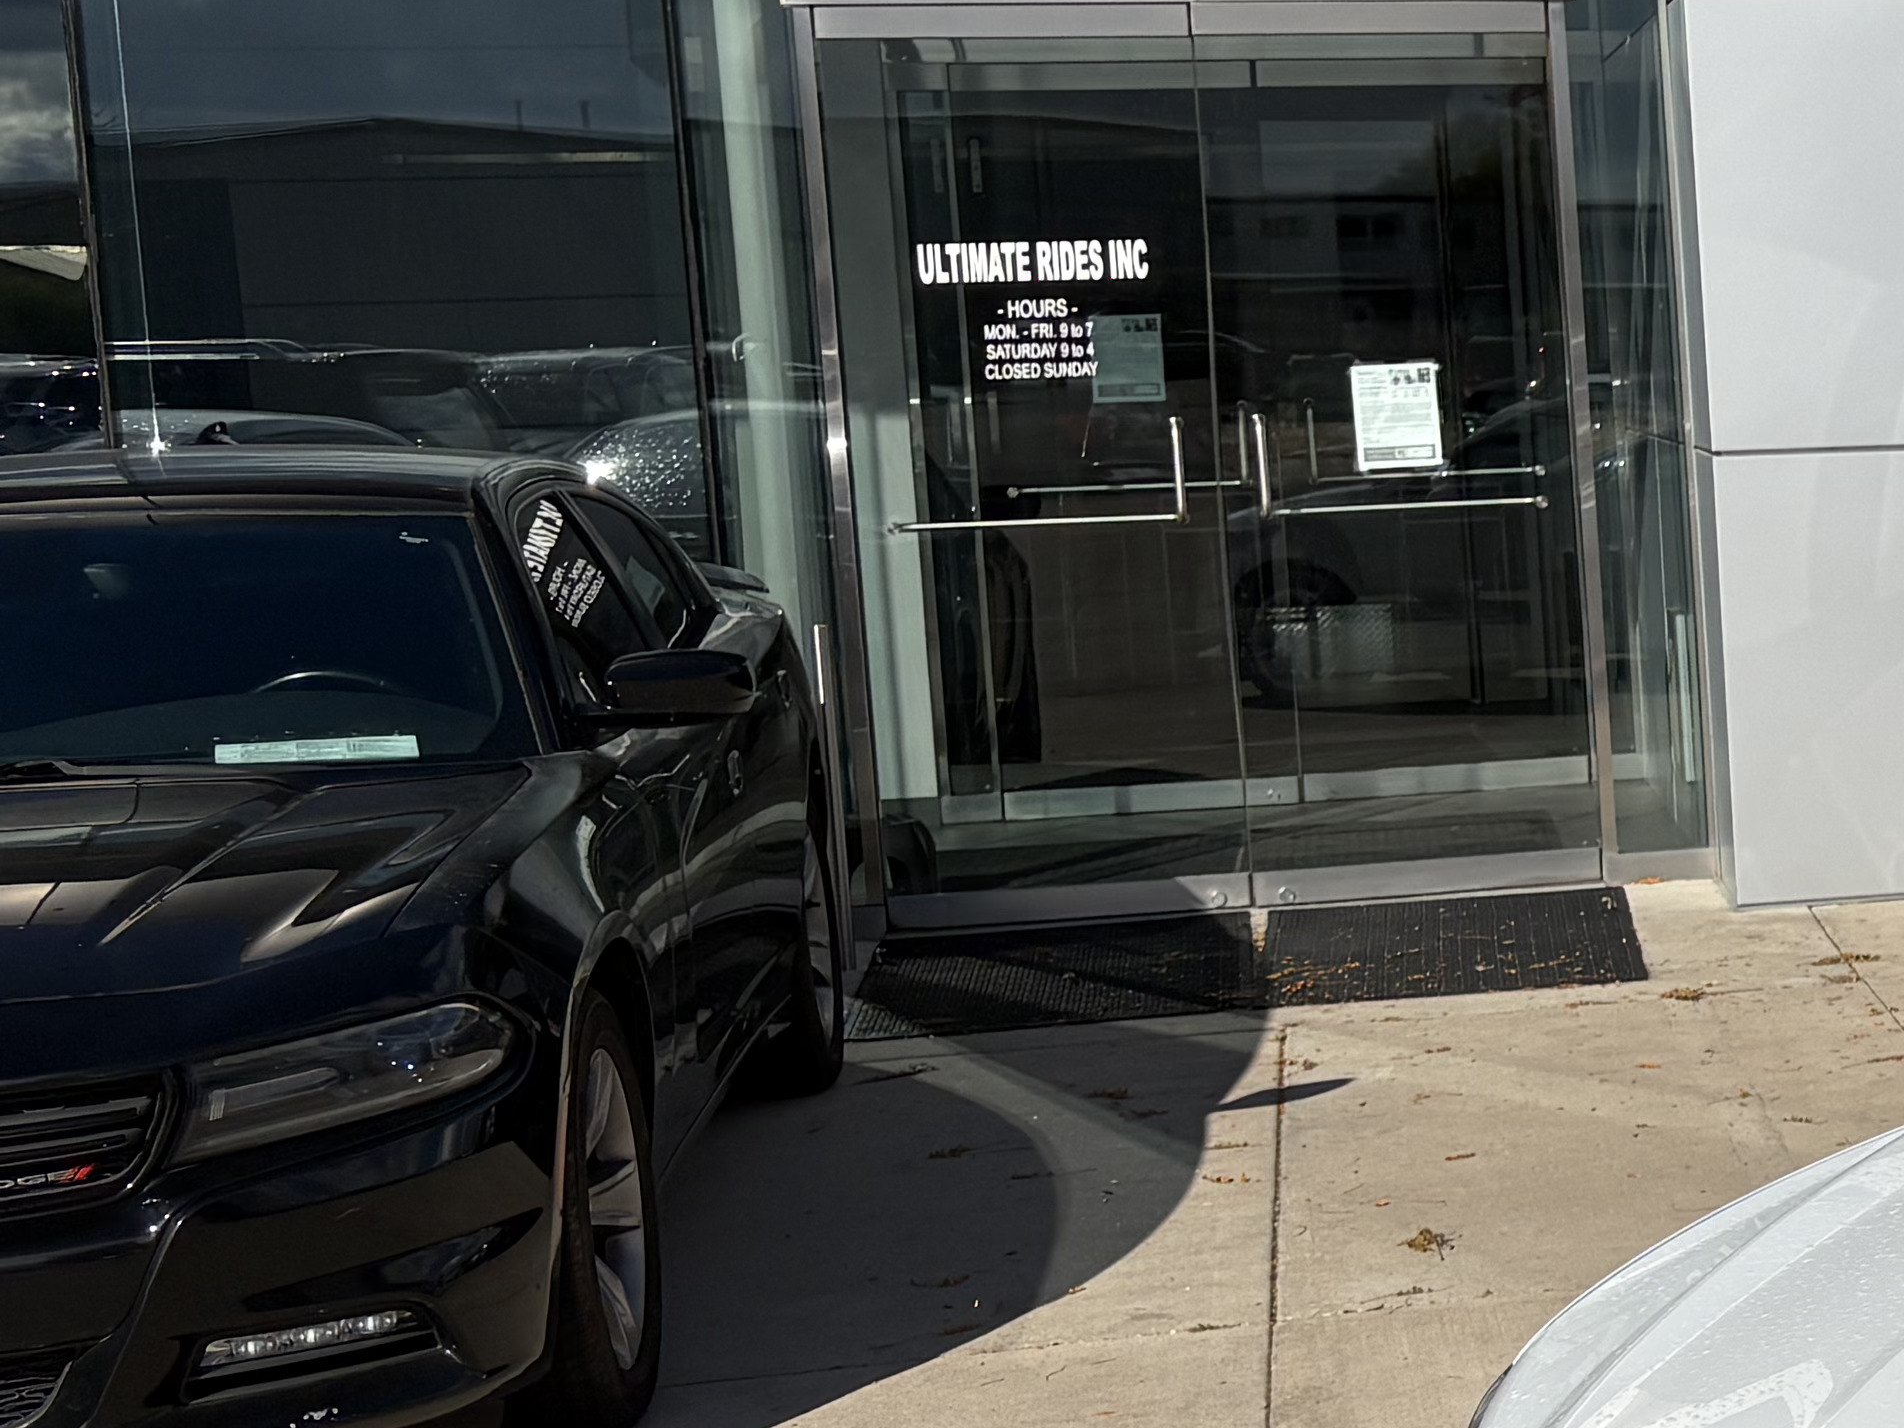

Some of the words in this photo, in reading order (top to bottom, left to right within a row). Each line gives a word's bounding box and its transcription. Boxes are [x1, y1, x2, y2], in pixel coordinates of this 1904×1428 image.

[916, 241, 1032, 285] ULTIMATE
[1036, 239, 1104, 282] RIDES
[1108, 238, 1149, 280] INC
[1007, 298, 1068, 319] HOURS
[984, 324, 1019, 341] MON.
[1031, 323, 1058, 340] FRI.
[1060, 323, 1067, 339] 9
[1071, 323, 1083, 338] to
[1085, 321, 1093, 338] 7
[986, 342, 1058, 361] SATURDAY
[1060, 343, 1070, 358] 9
[1072, 342, 1084, 357] to
[1086, 340, 1095, 357] 4
[985, 362, 1041, 380] CLOSED
[1043, 361, 1098, 379] SUNDAY
